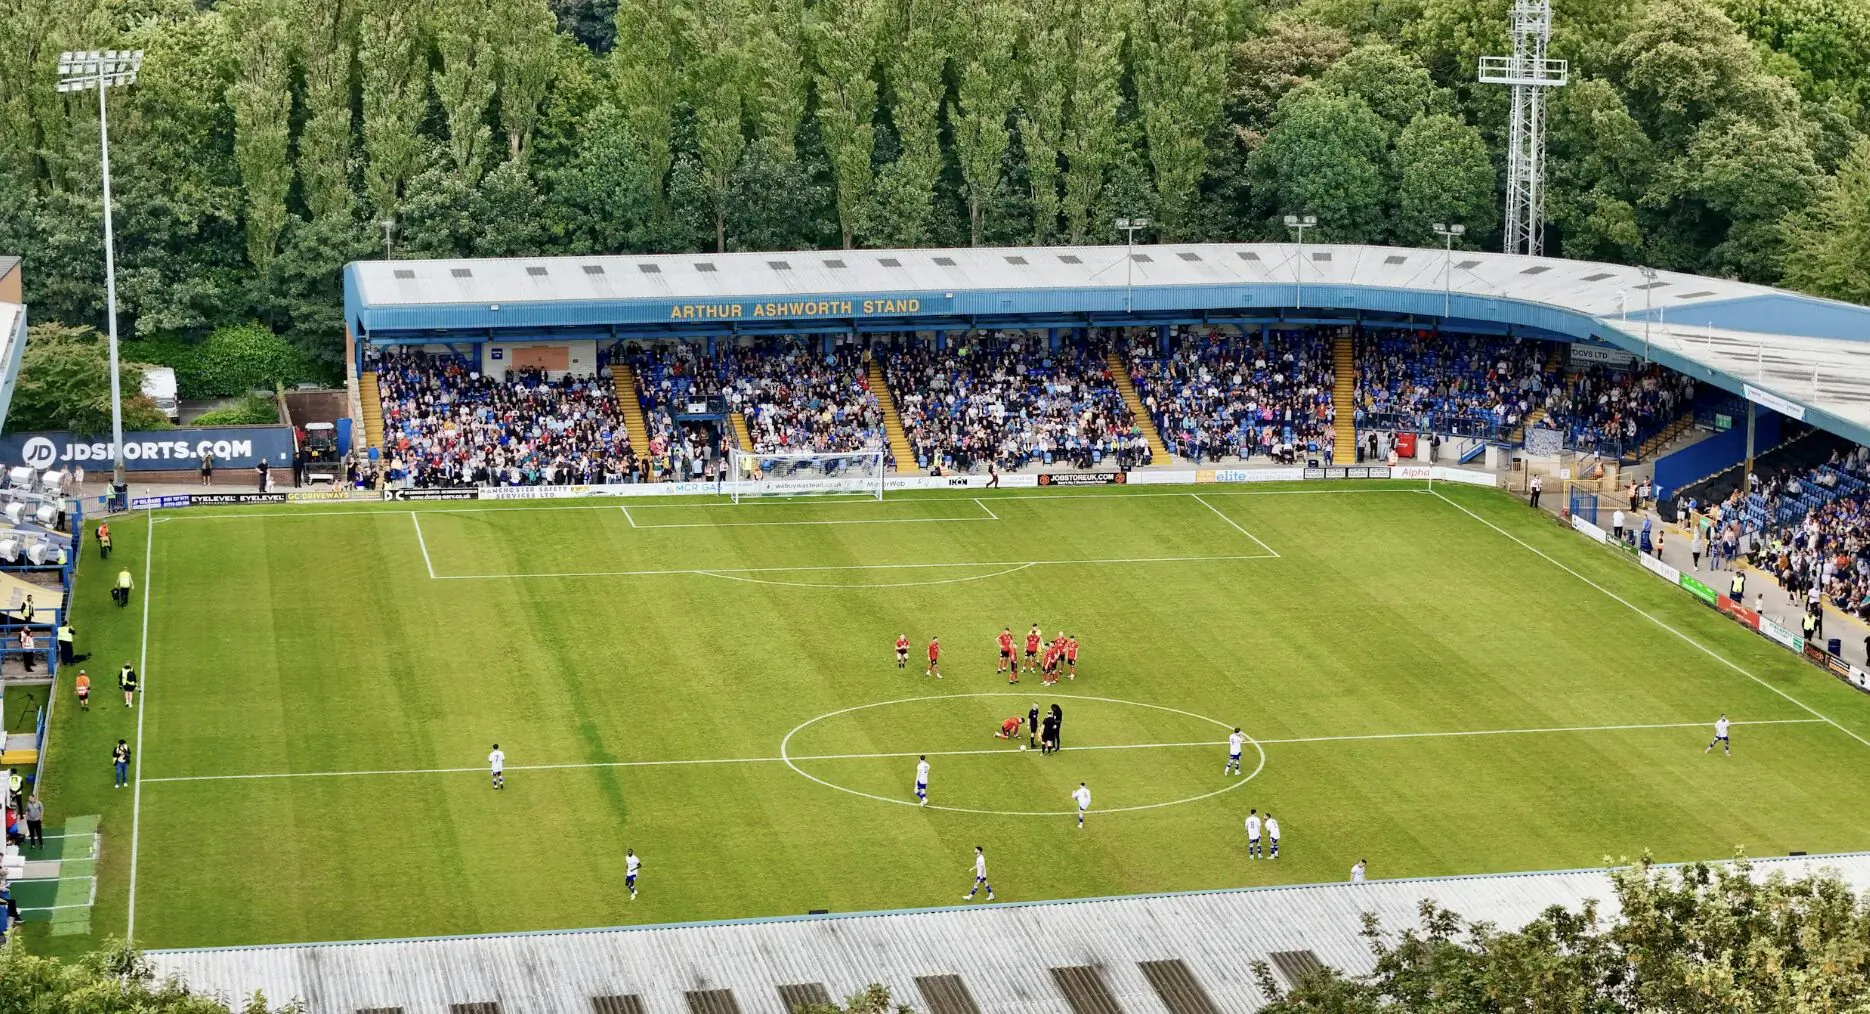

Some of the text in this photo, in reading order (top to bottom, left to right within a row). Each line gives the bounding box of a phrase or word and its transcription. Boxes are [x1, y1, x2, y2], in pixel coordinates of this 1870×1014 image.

[671, 299, 920, 318] ARTHUR ASHWORTH STAND
[1050, 473, 1114, 482] JOBSTOREUK.COM
[1216, 471, 1246, 481] elite
[479, 486, 535, 494] MANCHESTER
[675, 483, 698, 492] MCR
[302, 492, 350, 500] DRIVEWAYS
